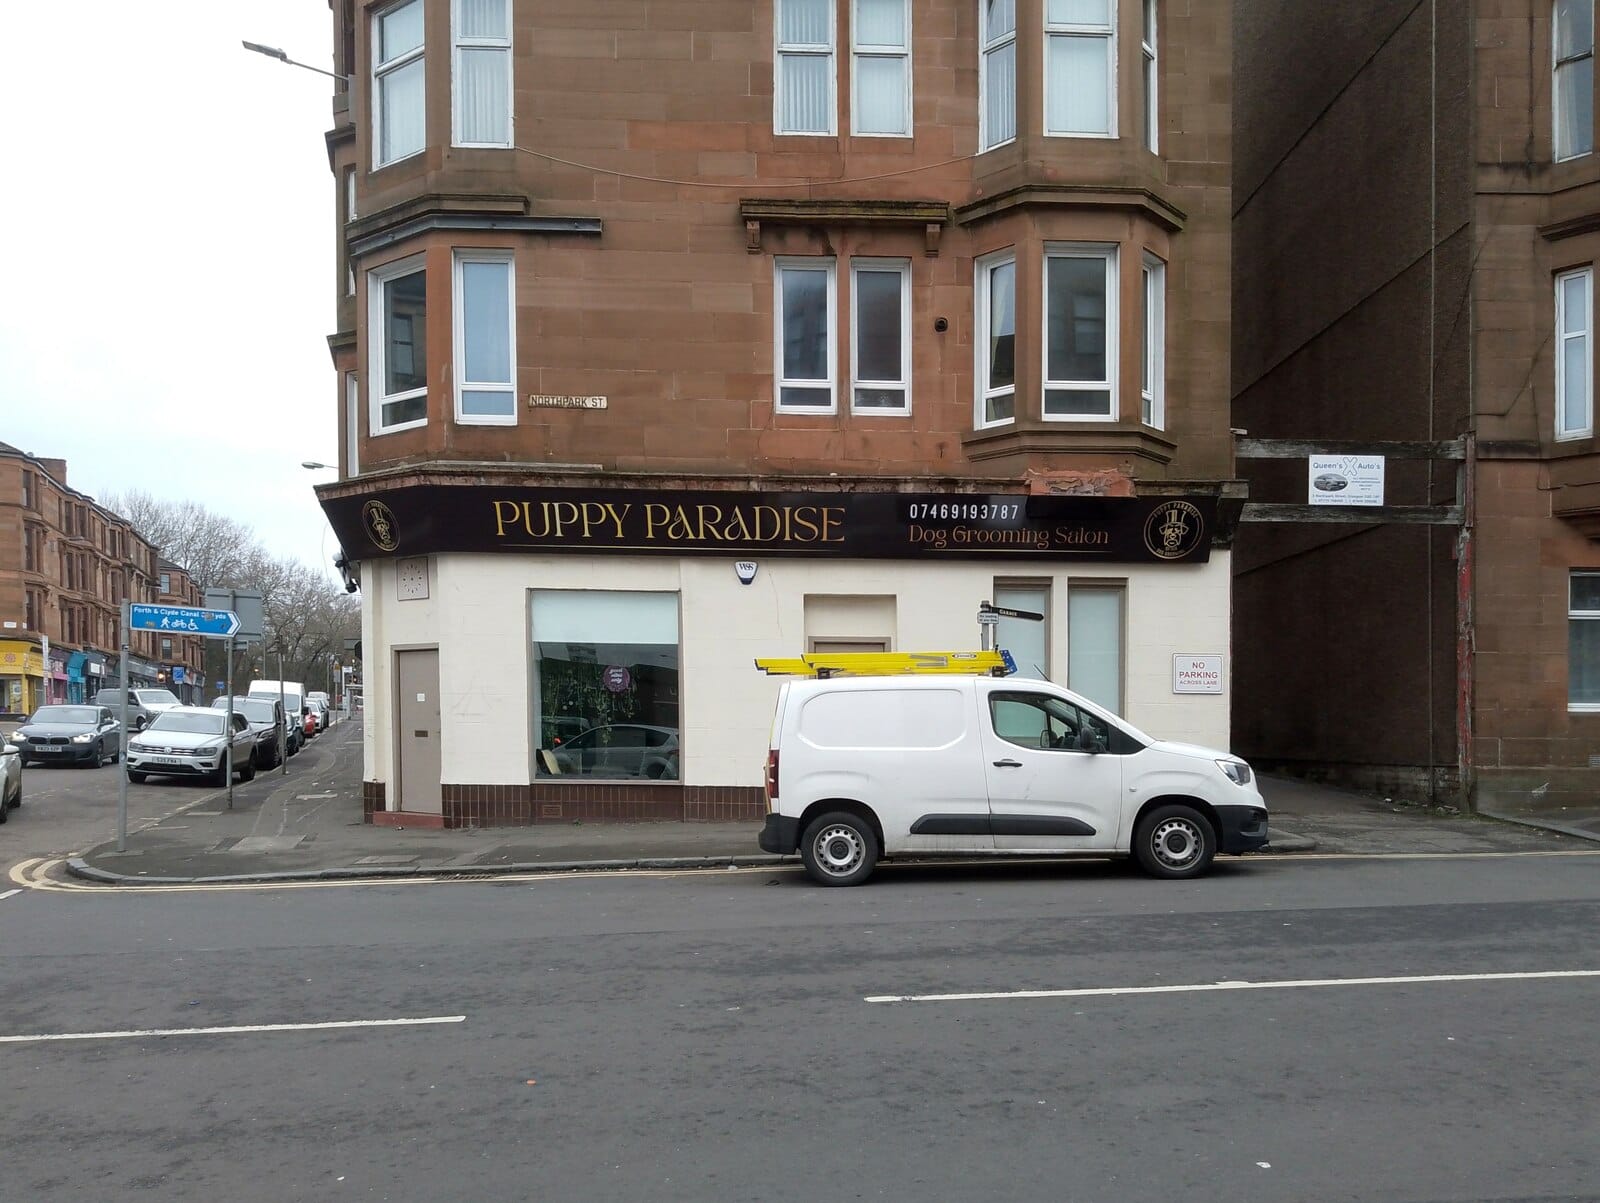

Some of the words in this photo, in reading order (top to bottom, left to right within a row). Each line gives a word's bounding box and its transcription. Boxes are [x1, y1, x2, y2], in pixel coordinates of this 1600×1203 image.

[531, 395, 588, 407] NORTHPARK
[909, 503, 1019, 520] 07469193787
[493, 501, 632, 539] PUPPY
[644, 503, 846, 542] PARADISE
[909, 525, 947, 548] Dog
[952, 525, 1049, 550] Grooming
[1055, 526, 1109, 545] Salon
[134, 606, 152, 614] Forth
[180, 610, 200, 618] Canal
[1192, 661, 1206, 669] NO
[1179, 671, 1218, 679] PARKING
